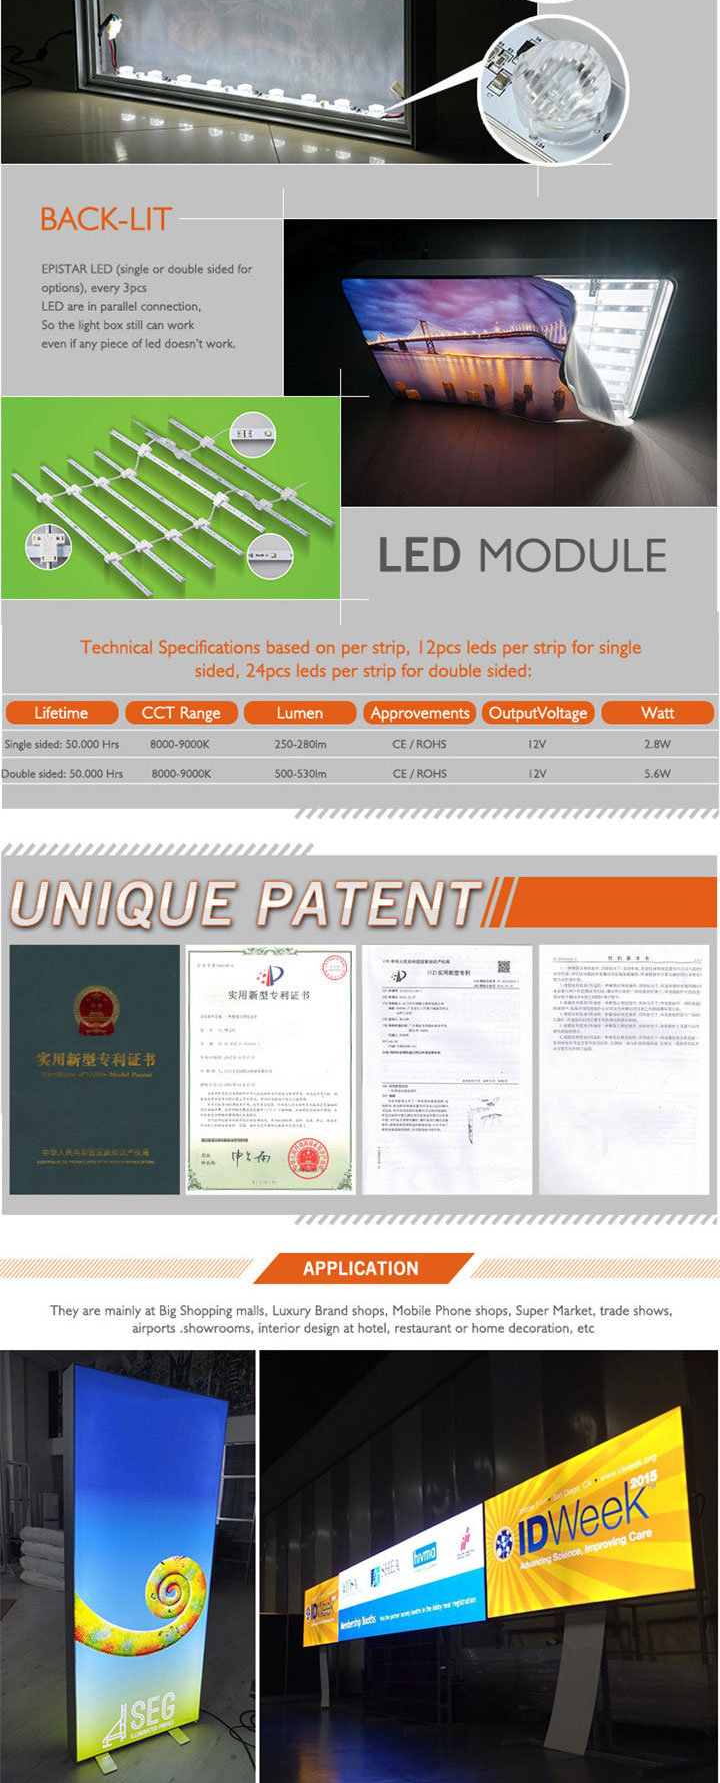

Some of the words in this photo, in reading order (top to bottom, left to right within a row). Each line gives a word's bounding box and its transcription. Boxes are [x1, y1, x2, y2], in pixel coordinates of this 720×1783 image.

[228, 991, 309, 1000] 实用新型专利证书
[37, 1052, 155, 1067] 实用新型专利证书
[630, 1469, 658, 1490] 2015
[518, 1481, 649, 1557] IDWeek
[519, 1554, 552, 1570] Advancing
[553, 1547, 584, 1562] Science,
[584, 1535, 627, 1554] Improving
[629, 1529, 653, 1543] Care
[131, 1692, 176, 1730] SEG
